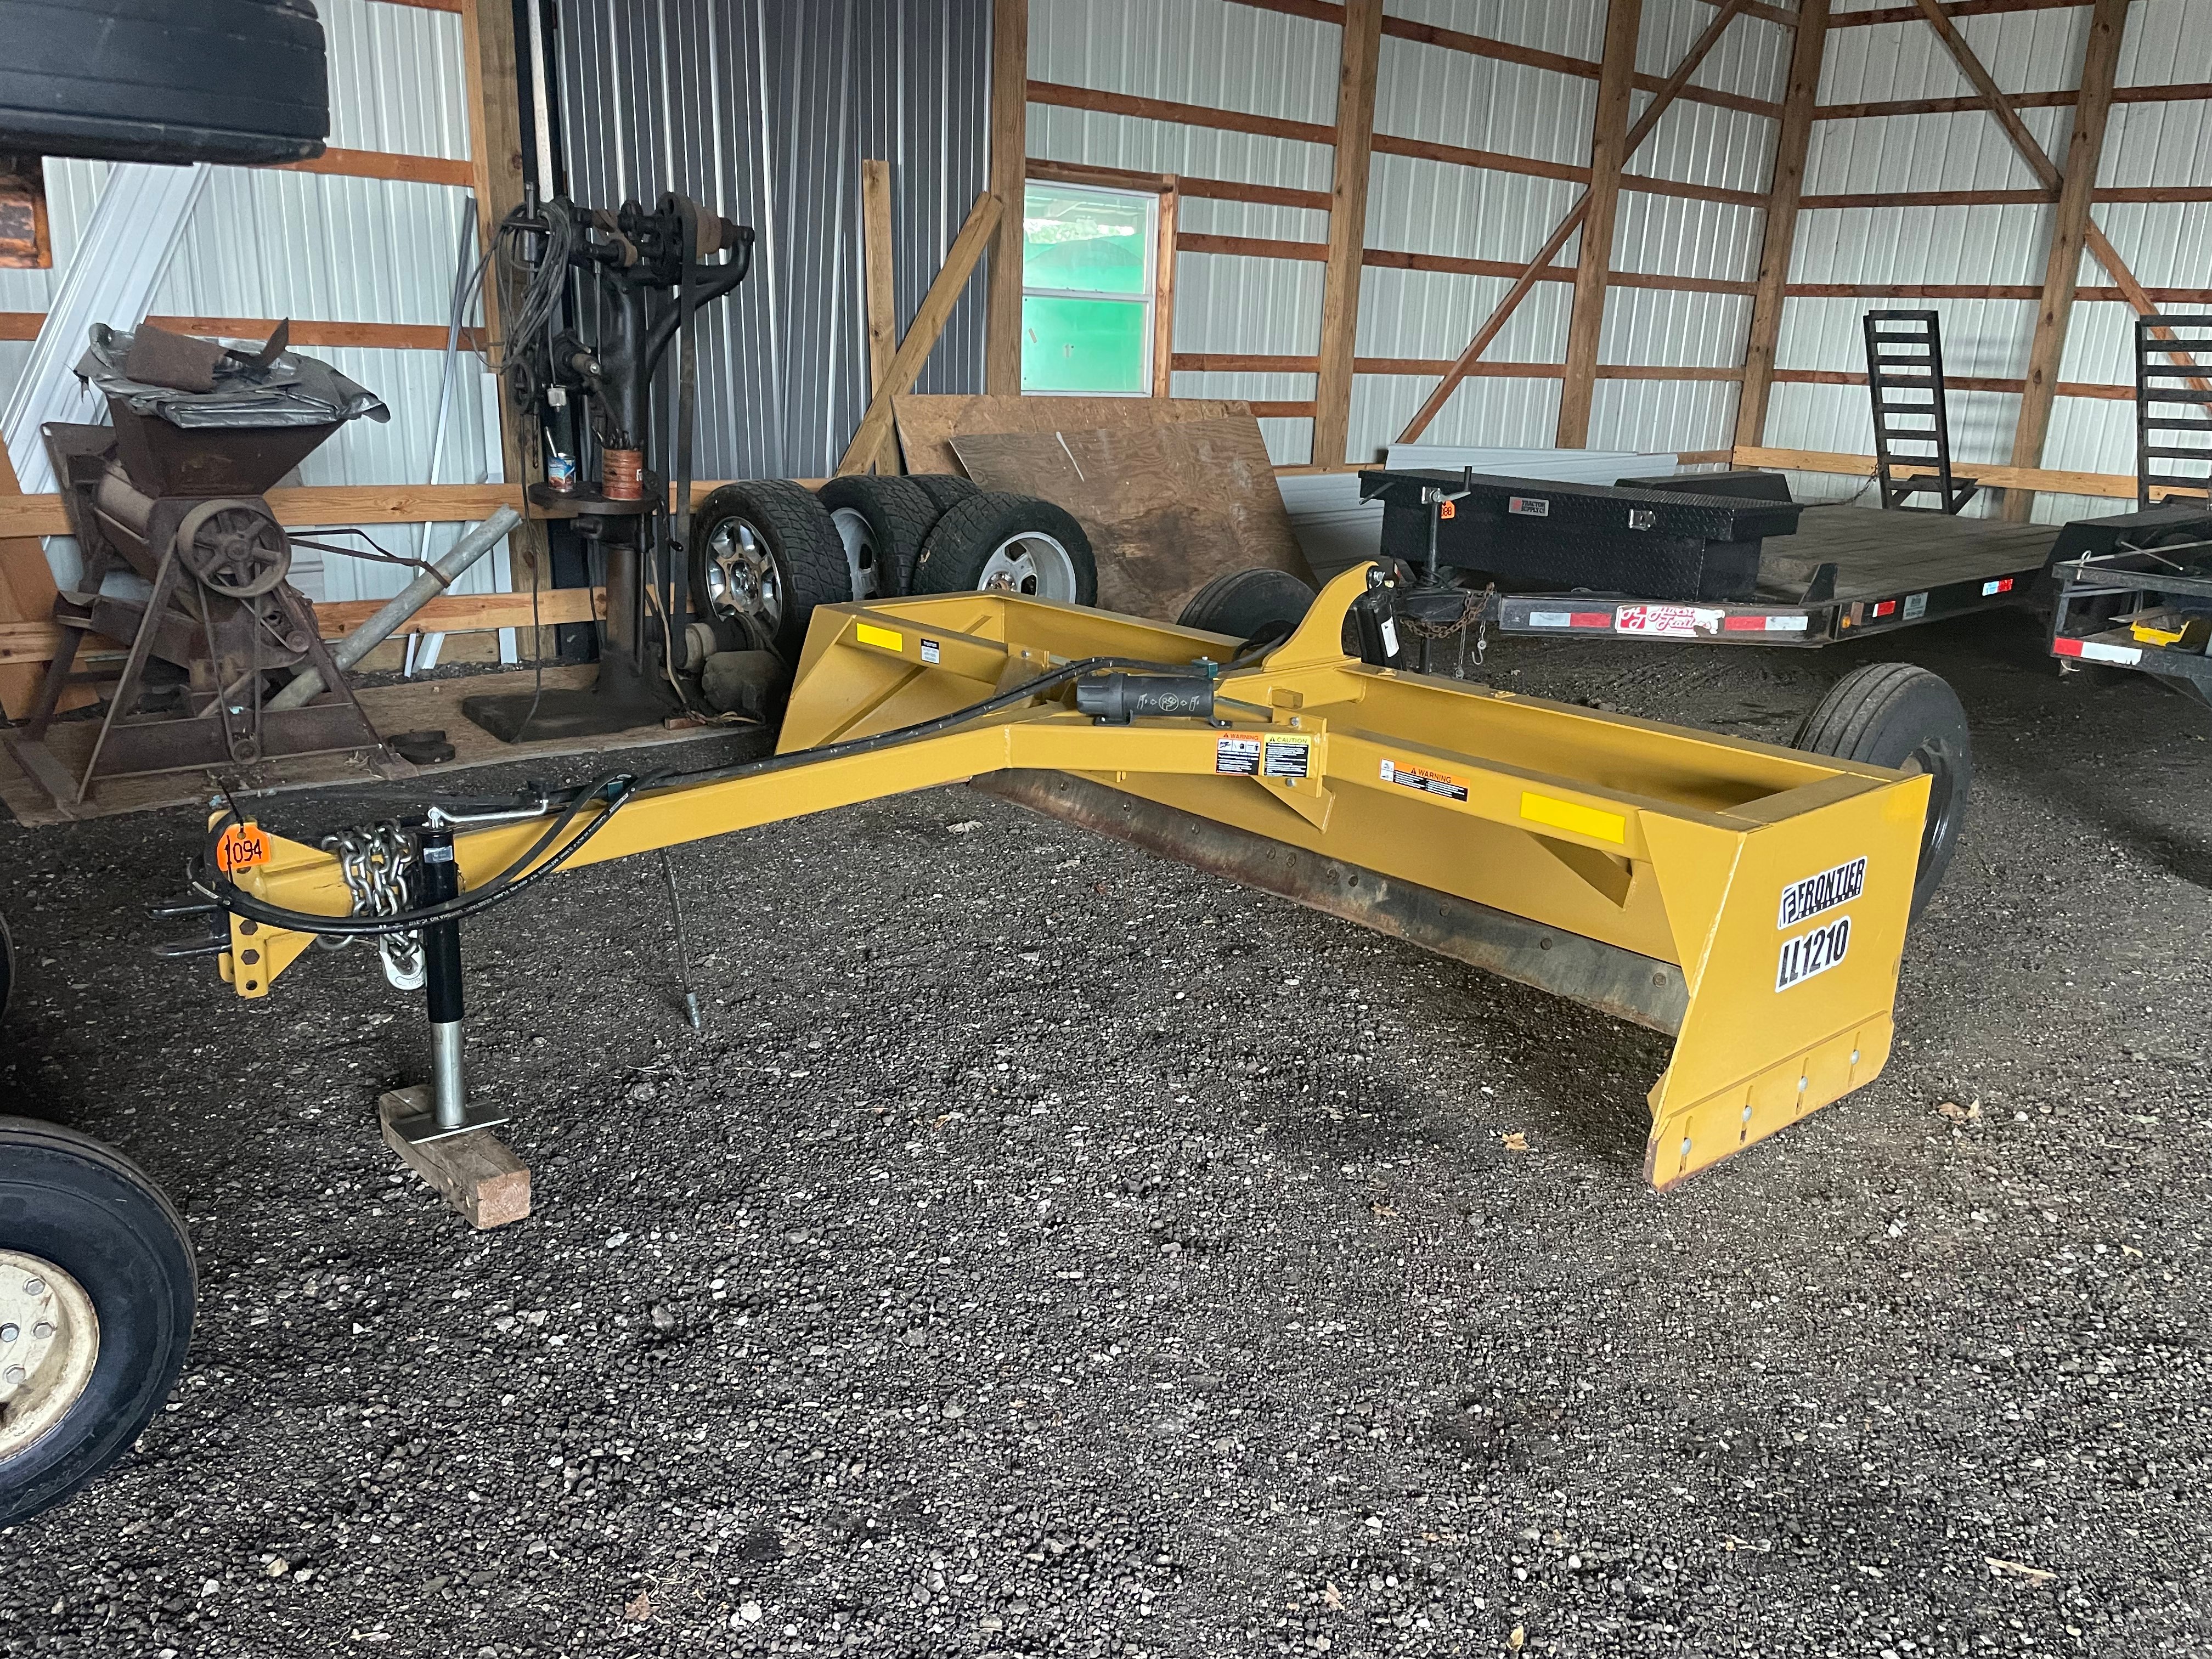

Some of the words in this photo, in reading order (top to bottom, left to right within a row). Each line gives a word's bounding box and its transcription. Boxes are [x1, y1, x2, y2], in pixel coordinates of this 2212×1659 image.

[1418, 769, 1452, 783] WARNING
[224, 835, 262, 864] 1094
[1798, 859, 1865, 913] FRONTIER
[1779, 920, 1849, 988] LL1210
